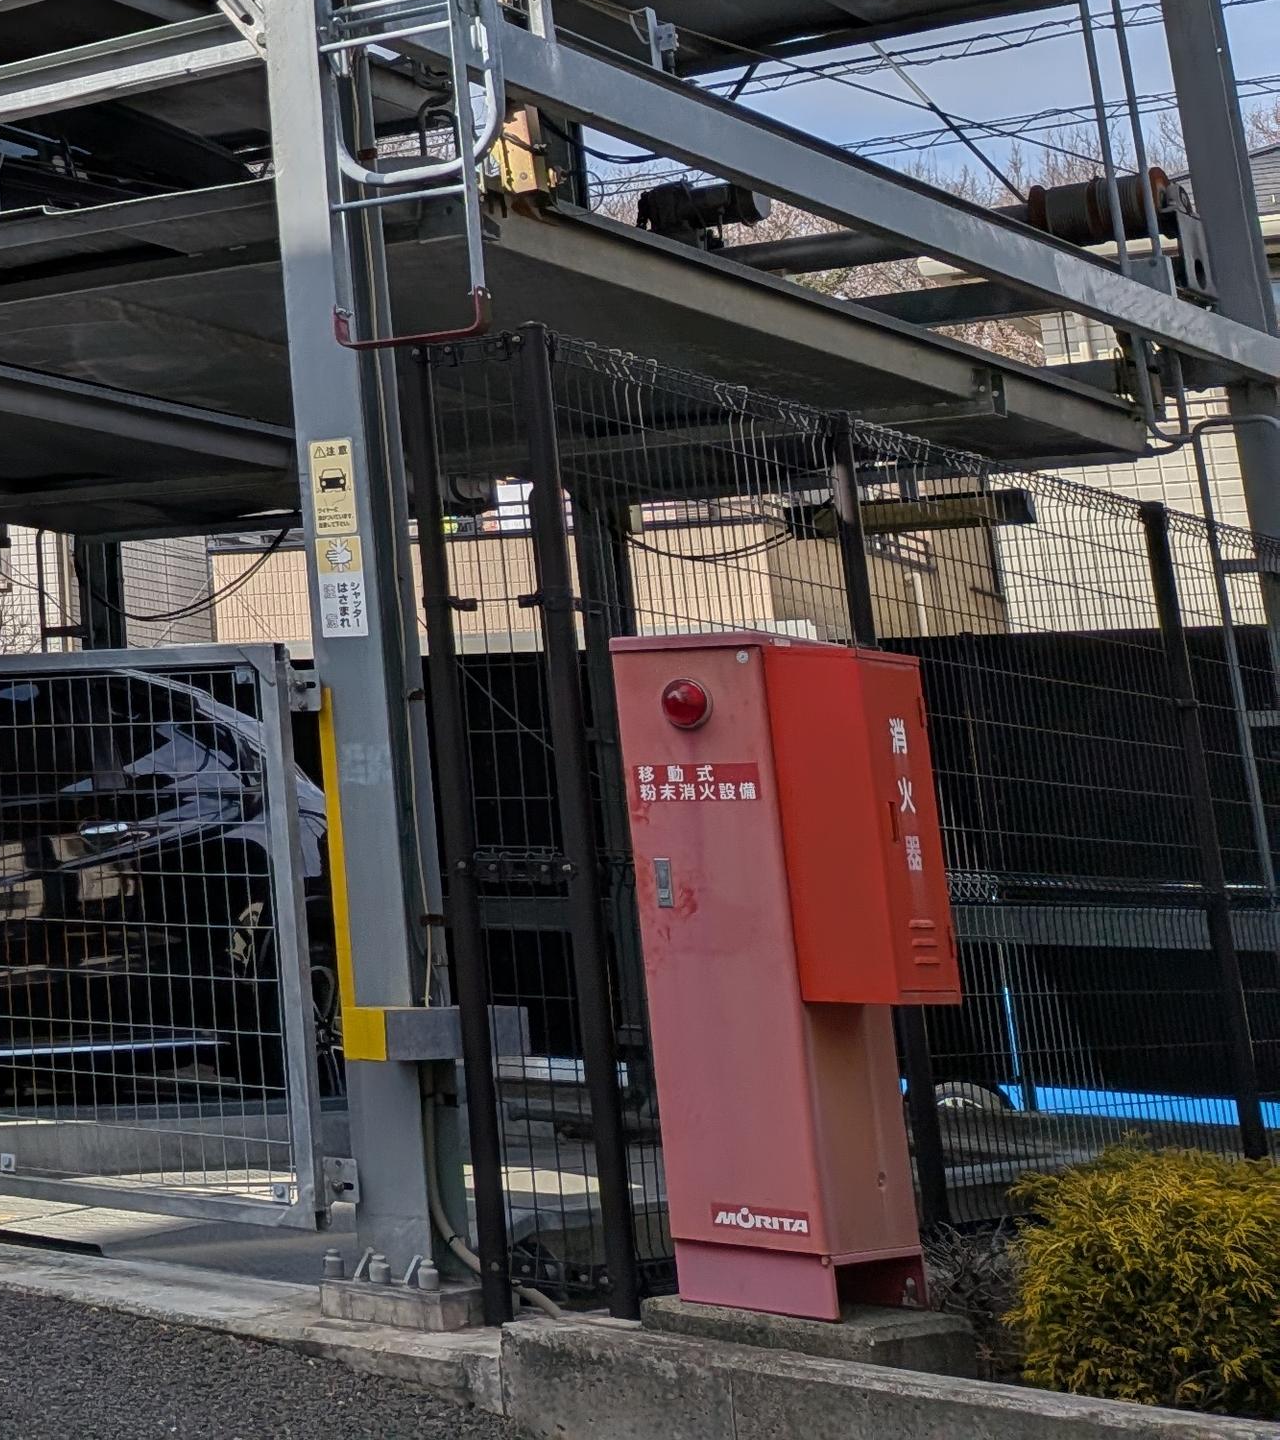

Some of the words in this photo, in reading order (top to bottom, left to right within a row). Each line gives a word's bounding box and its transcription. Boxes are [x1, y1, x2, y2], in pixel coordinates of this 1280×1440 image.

[326, 445, 348, 456] 注意
[337, 582, 351, 628] はさまれ
[350, 582, 362, 627] シャッター
[637, 764, 715, 782] 移動式
[639, 782, 757, 801] 粉末消火設備
[889, 717, 923, 871] 消火器
[714, 1207, 809, 1233] MORITA
